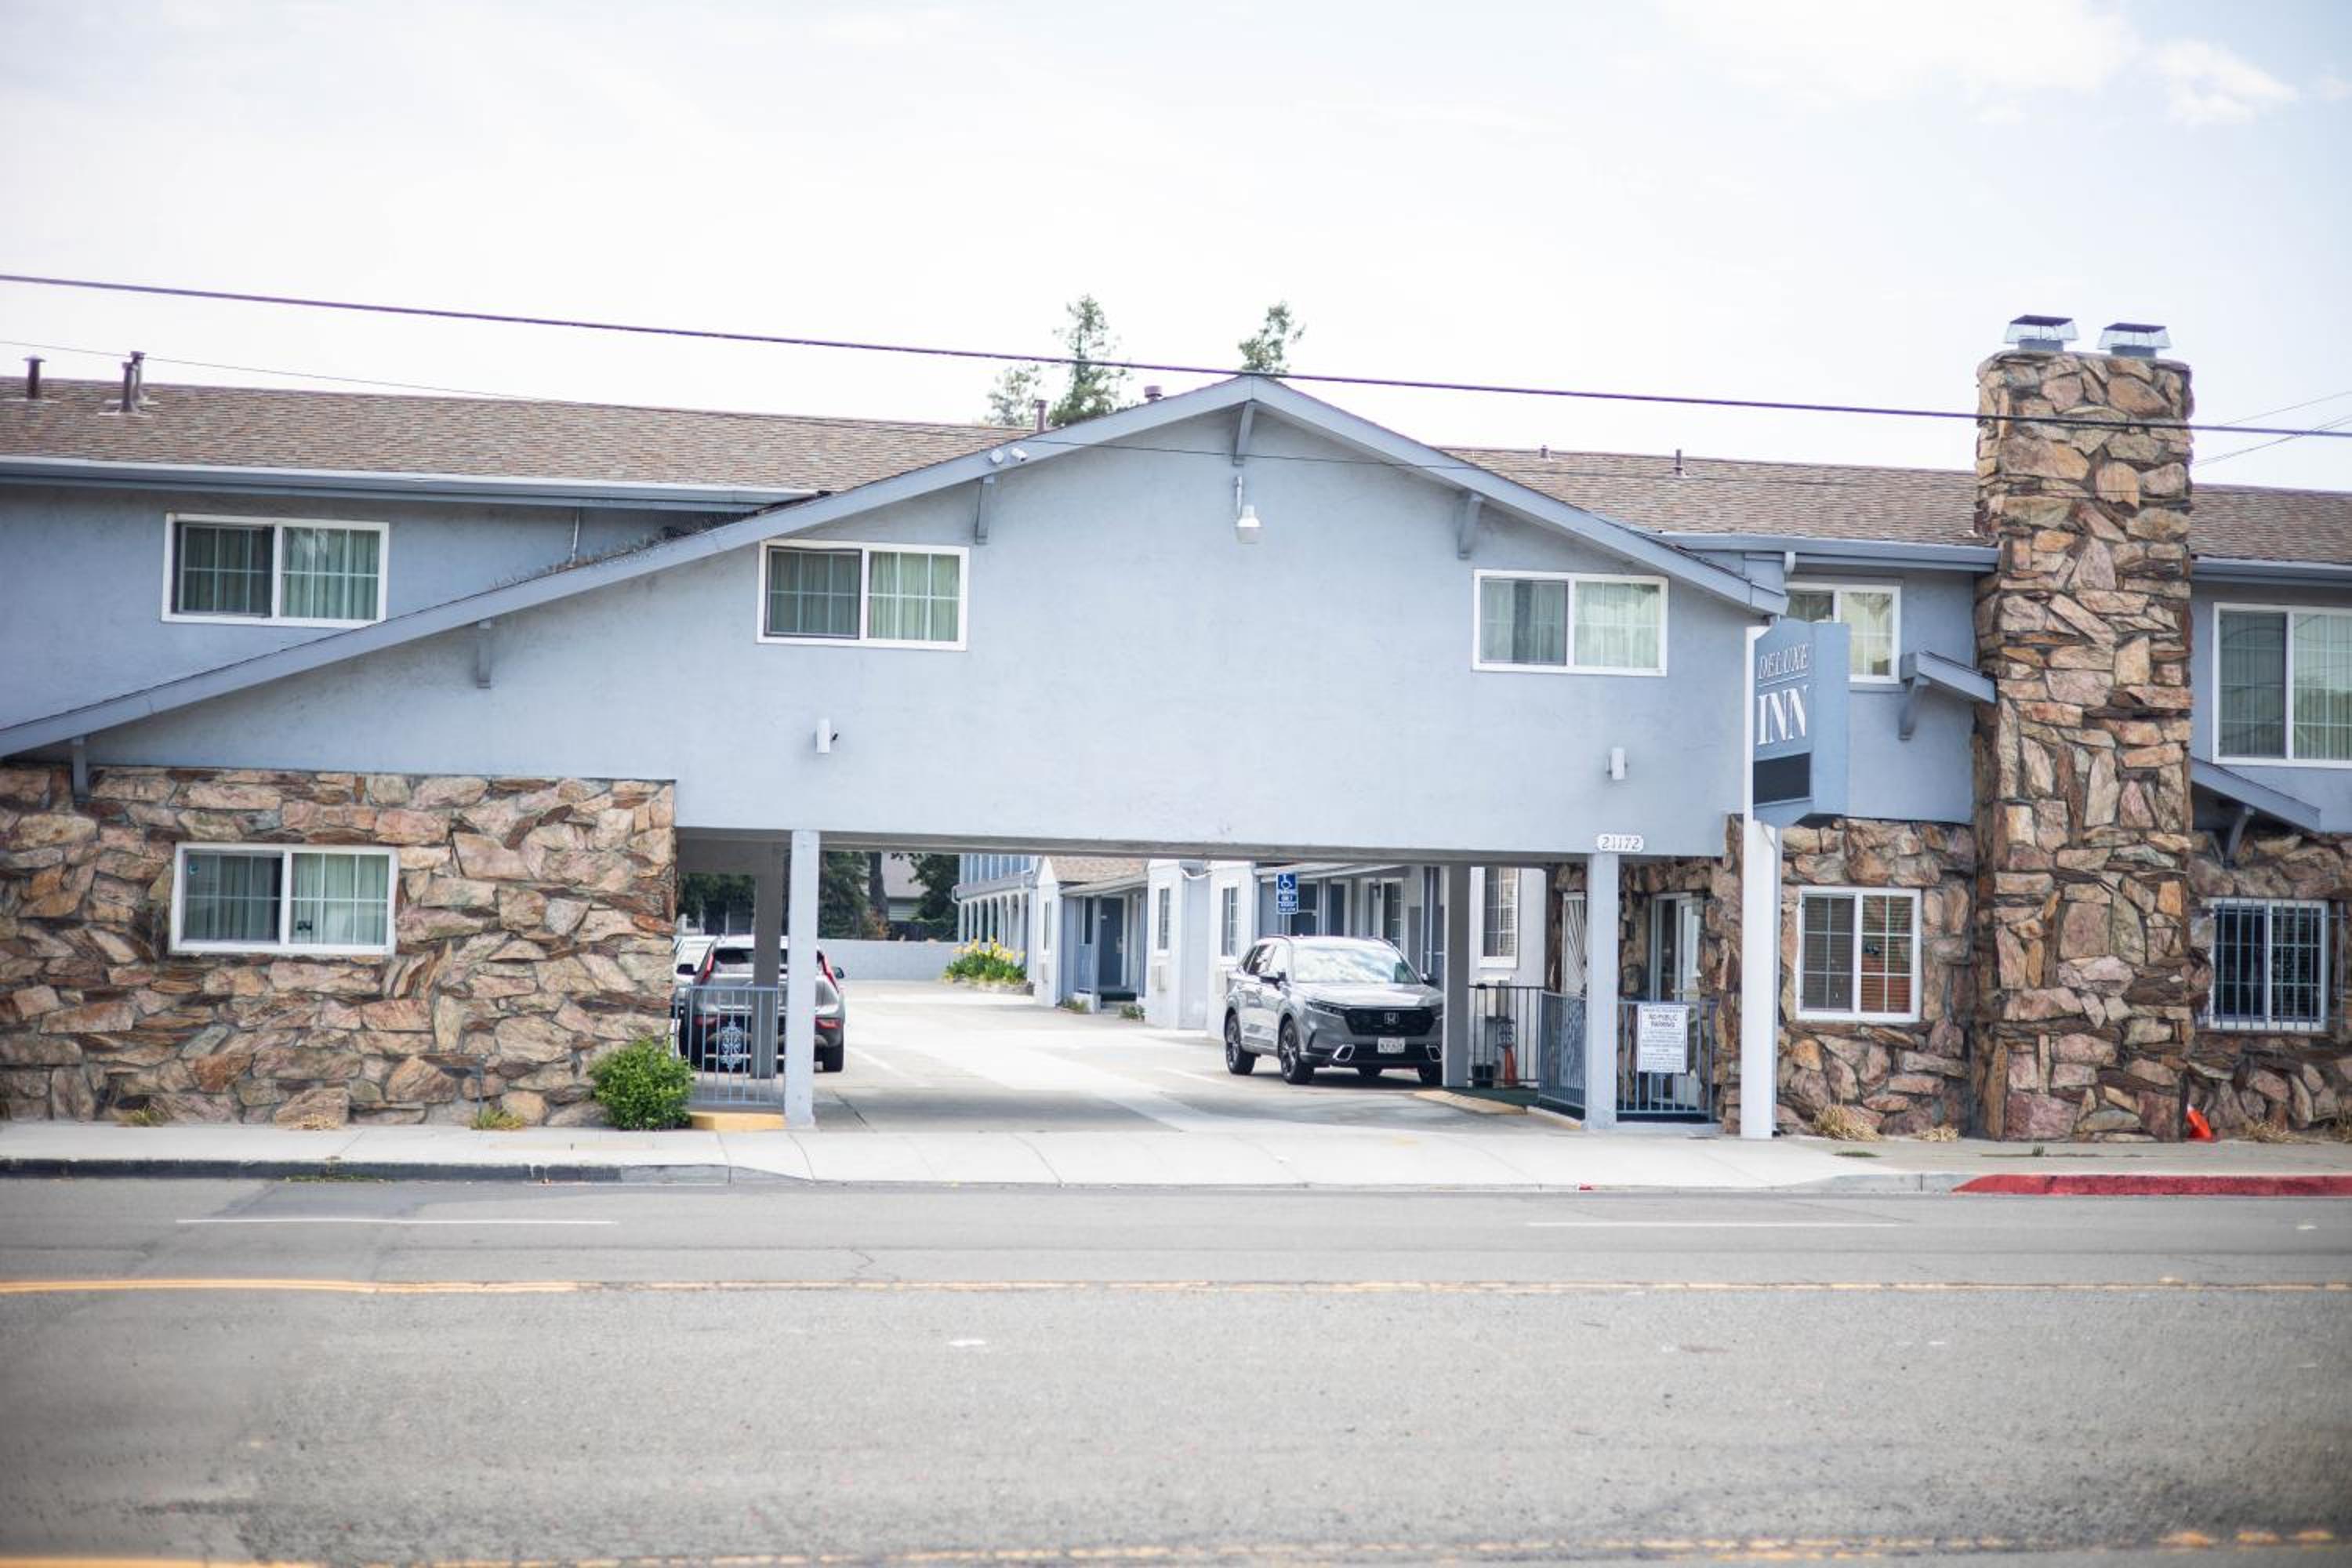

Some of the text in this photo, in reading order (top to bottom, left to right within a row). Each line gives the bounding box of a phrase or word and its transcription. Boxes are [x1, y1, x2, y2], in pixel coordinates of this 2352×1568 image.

[1758, 642, 1809, 679] DELUXE
[1757, 684, 1809, 745] INN
[1601, 836, 1641, 850] 21172
